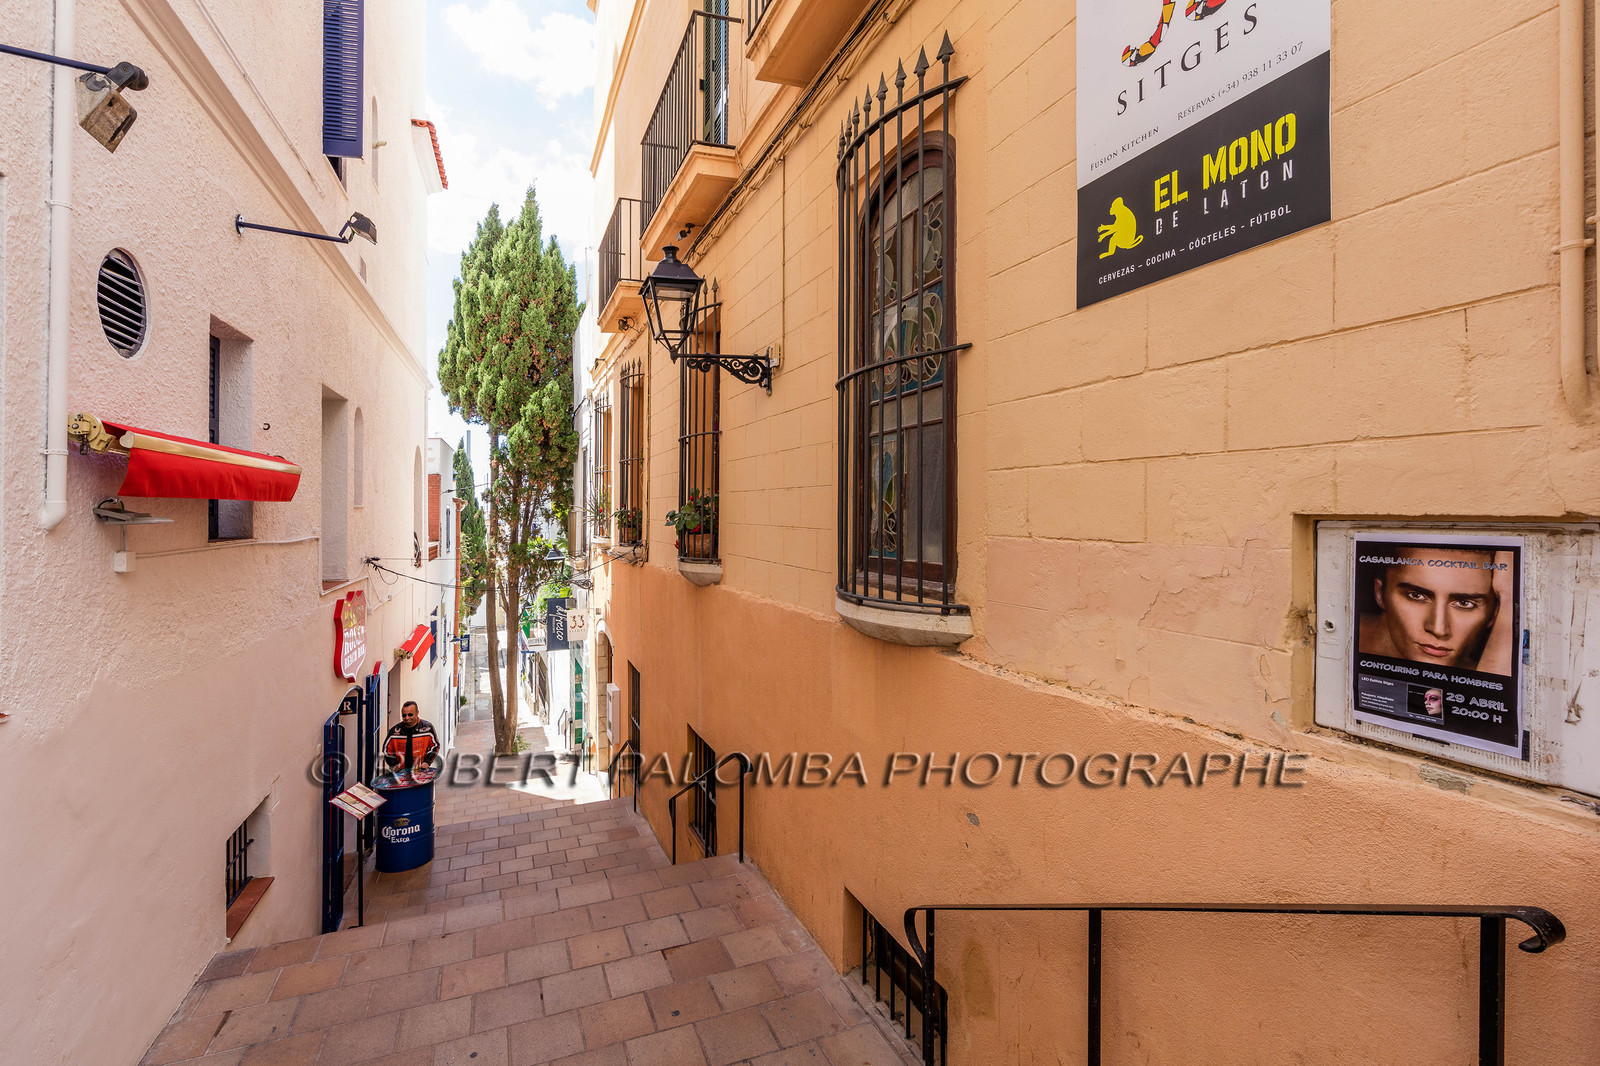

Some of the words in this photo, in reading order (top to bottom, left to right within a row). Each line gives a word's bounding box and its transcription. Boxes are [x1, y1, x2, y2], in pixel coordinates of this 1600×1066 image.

[1117, 3, 1258, 116] SITGES
[1177, 93, 1216, 121] RESERVAS
[1218, 79, 1240, 98] (+34)
[1242, 67, 1259, 84] 938
[1261, 60, 1273, 74] 11
[1276, 51, 1288, 65] 33
[1290, 41, 1304, 56] 07
[1090, 153, 1119, 171] FUSION
[1121, 126, 1160, 153] KITCHEN
[1154, 170, 1189, 212] EL
[1202, 113, 1297, 190] MONO
[1156, 210, 1180, 236] DE
[1203, 159, 1294, 216] LATON
[1098, 264, 1135, 285] CERVEZAS
[1145, 249, 1177, 267] COCINA
[1188, 225, 1236, 251] CÓCTELES
[1250, 204, 1291, 228] FÚTBOL
[1358, 555, 1425, 567] CASABLANCA
[1427, 559, 1480, 570] COCKTAIL
[1483, 562, 1509, 571] BAR
[569, 615, 585, 629] 33
[1360, 660, 1420, 676] CONTOURING
[1422, 670, 1448, 681] PARA
[1451, 675, 1503, 691] HOMBRES
[343, 701, 352, 711] R
[1446, 692, 1466, 703] 29
[1469, 697, 1509, 712] ABRIL
[1451, 706, 1490, 720] 20:00
[1492, 714, 1502, 724] H
[382, 824, 421, 839] Corona
